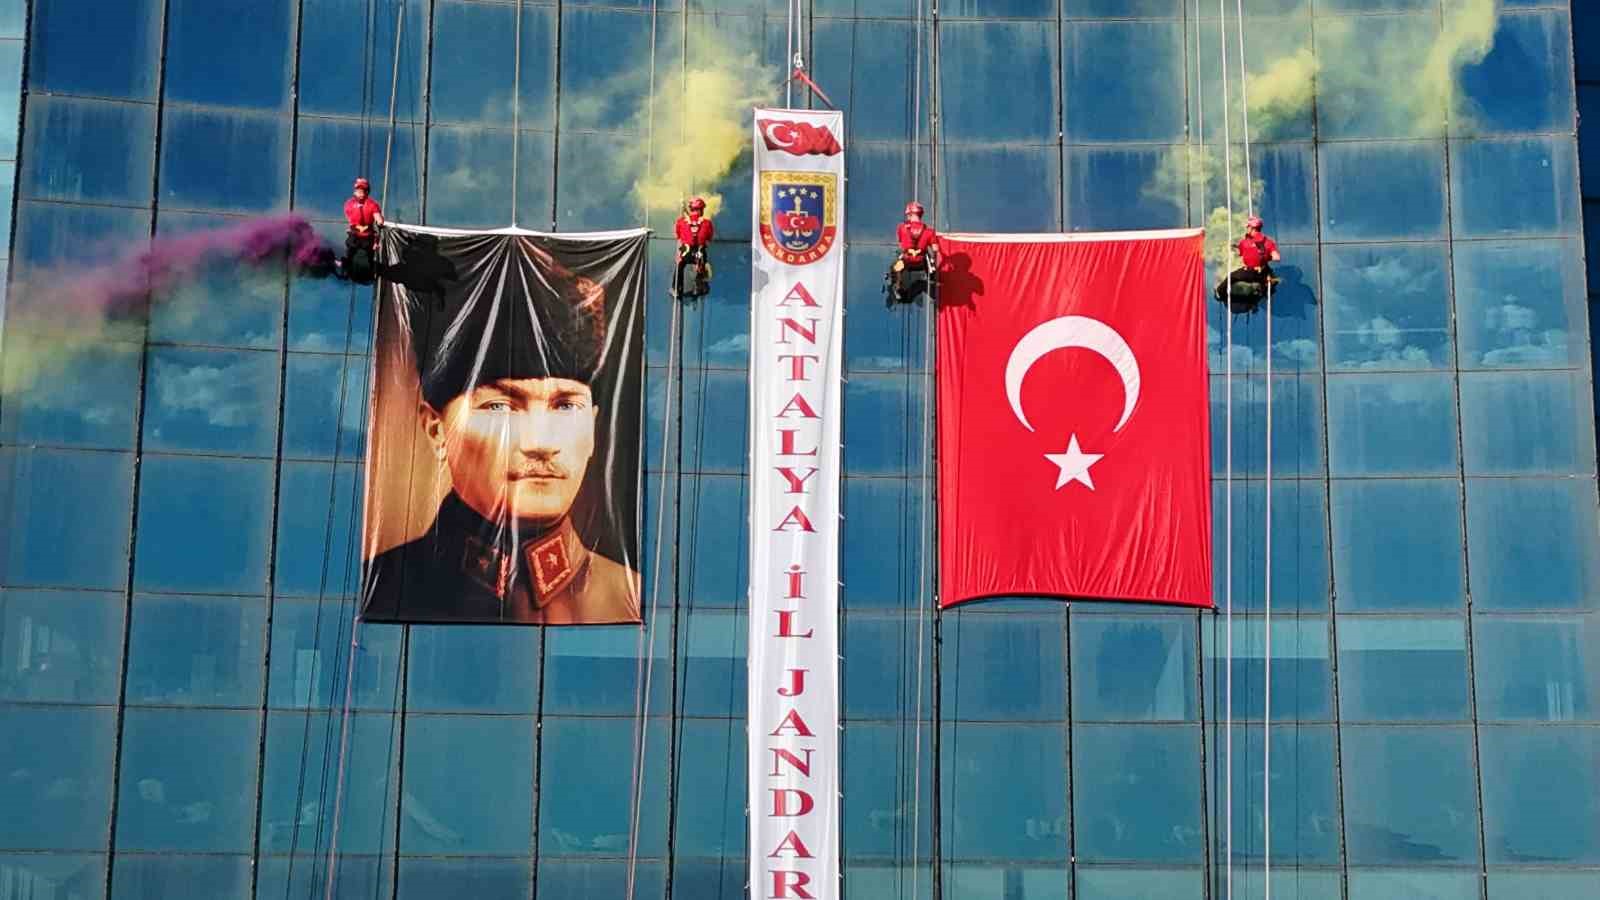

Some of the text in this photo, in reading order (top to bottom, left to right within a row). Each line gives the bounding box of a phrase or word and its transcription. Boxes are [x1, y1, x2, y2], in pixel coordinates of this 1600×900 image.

[763, 233, 832, 262] JANDARMA
[767, 281, 822, 899] ANTALYA İL JANDAR
